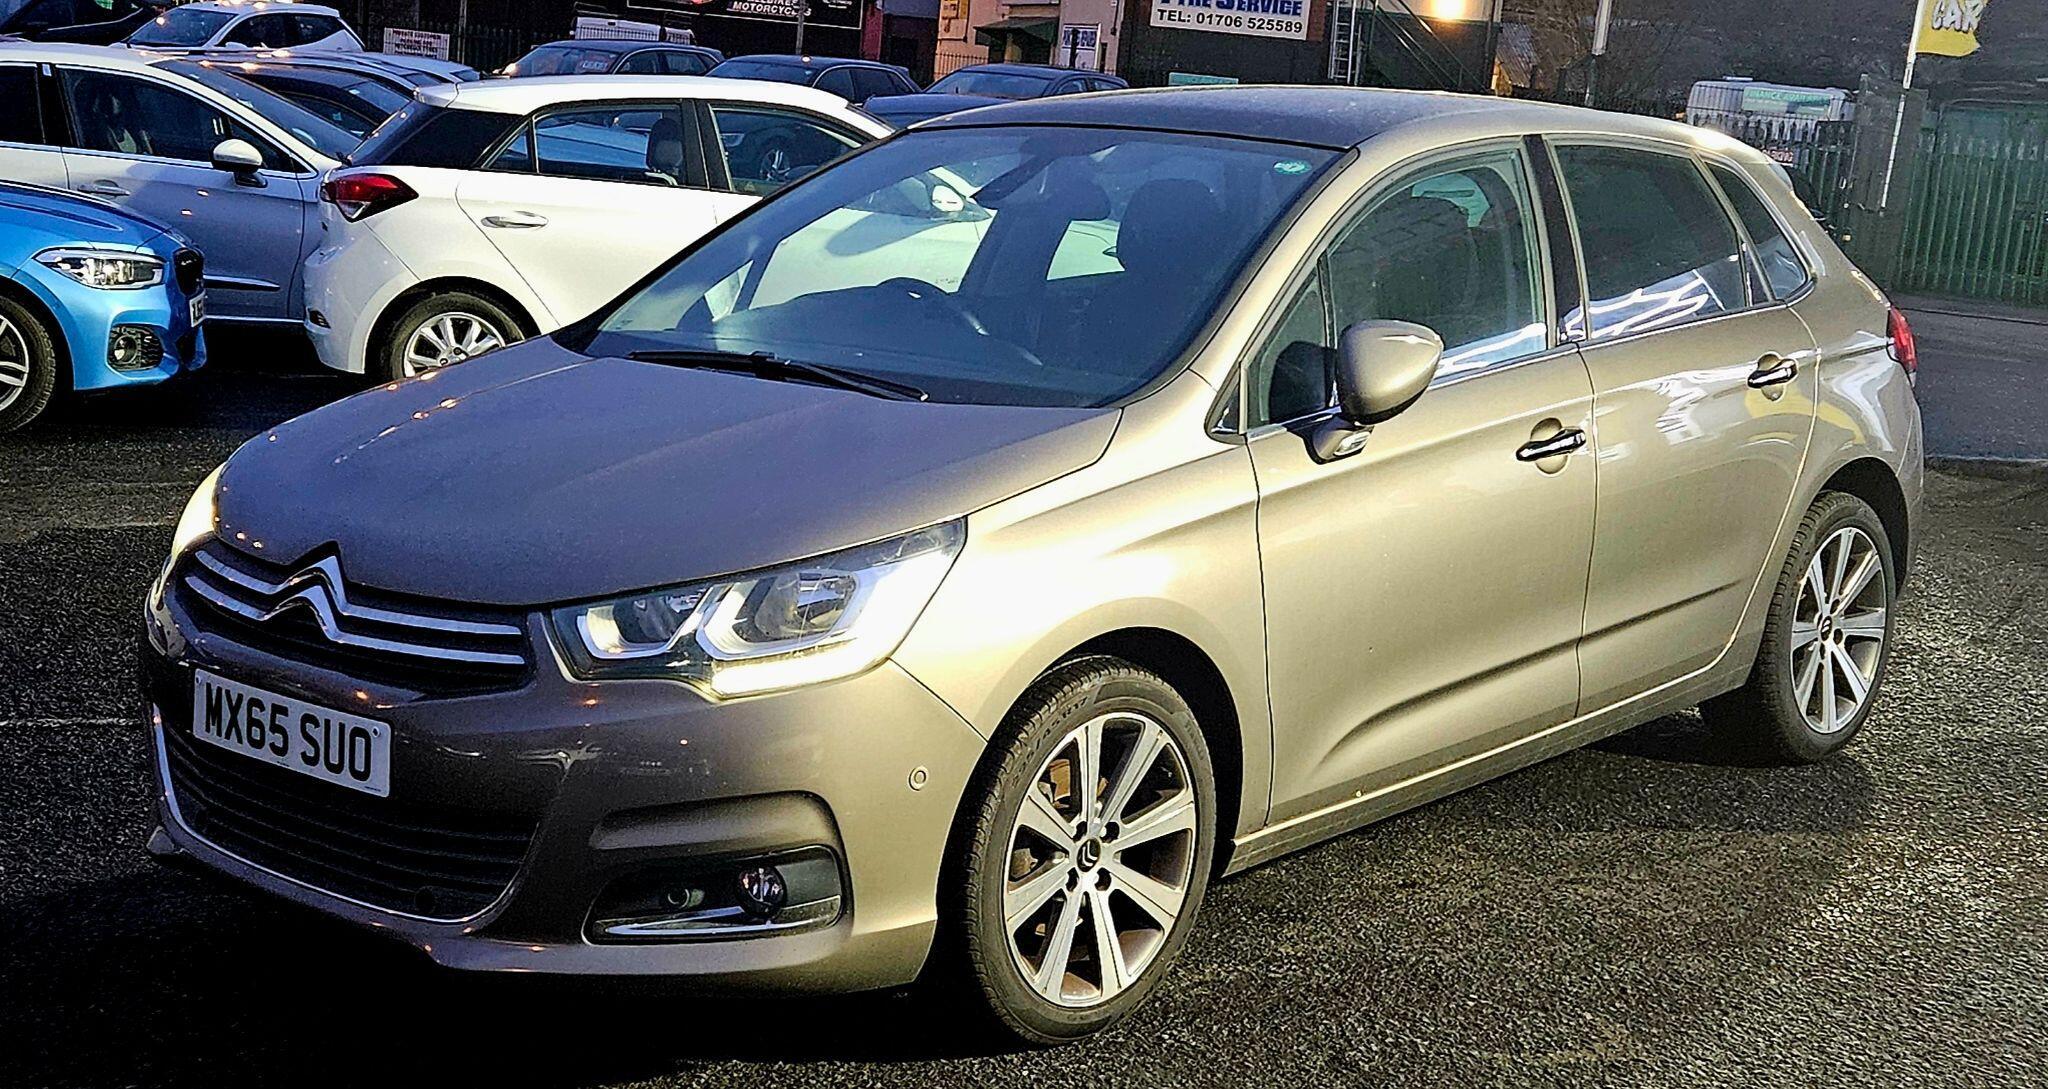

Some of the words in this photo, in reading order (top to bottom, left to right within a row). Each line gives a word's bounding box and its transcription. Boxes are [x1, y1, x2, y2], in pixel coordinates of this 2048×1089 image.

[733, 1, 811, 16] MOTORCYCLS
[1157, 9, 1191, 23] TEL:
[1196, 12, 1243, 28] 01706
[1247, 17, 1303, 34] 525589
[205, 682, 289, 757] MX65
[300, 713, 372, 782] SUO
